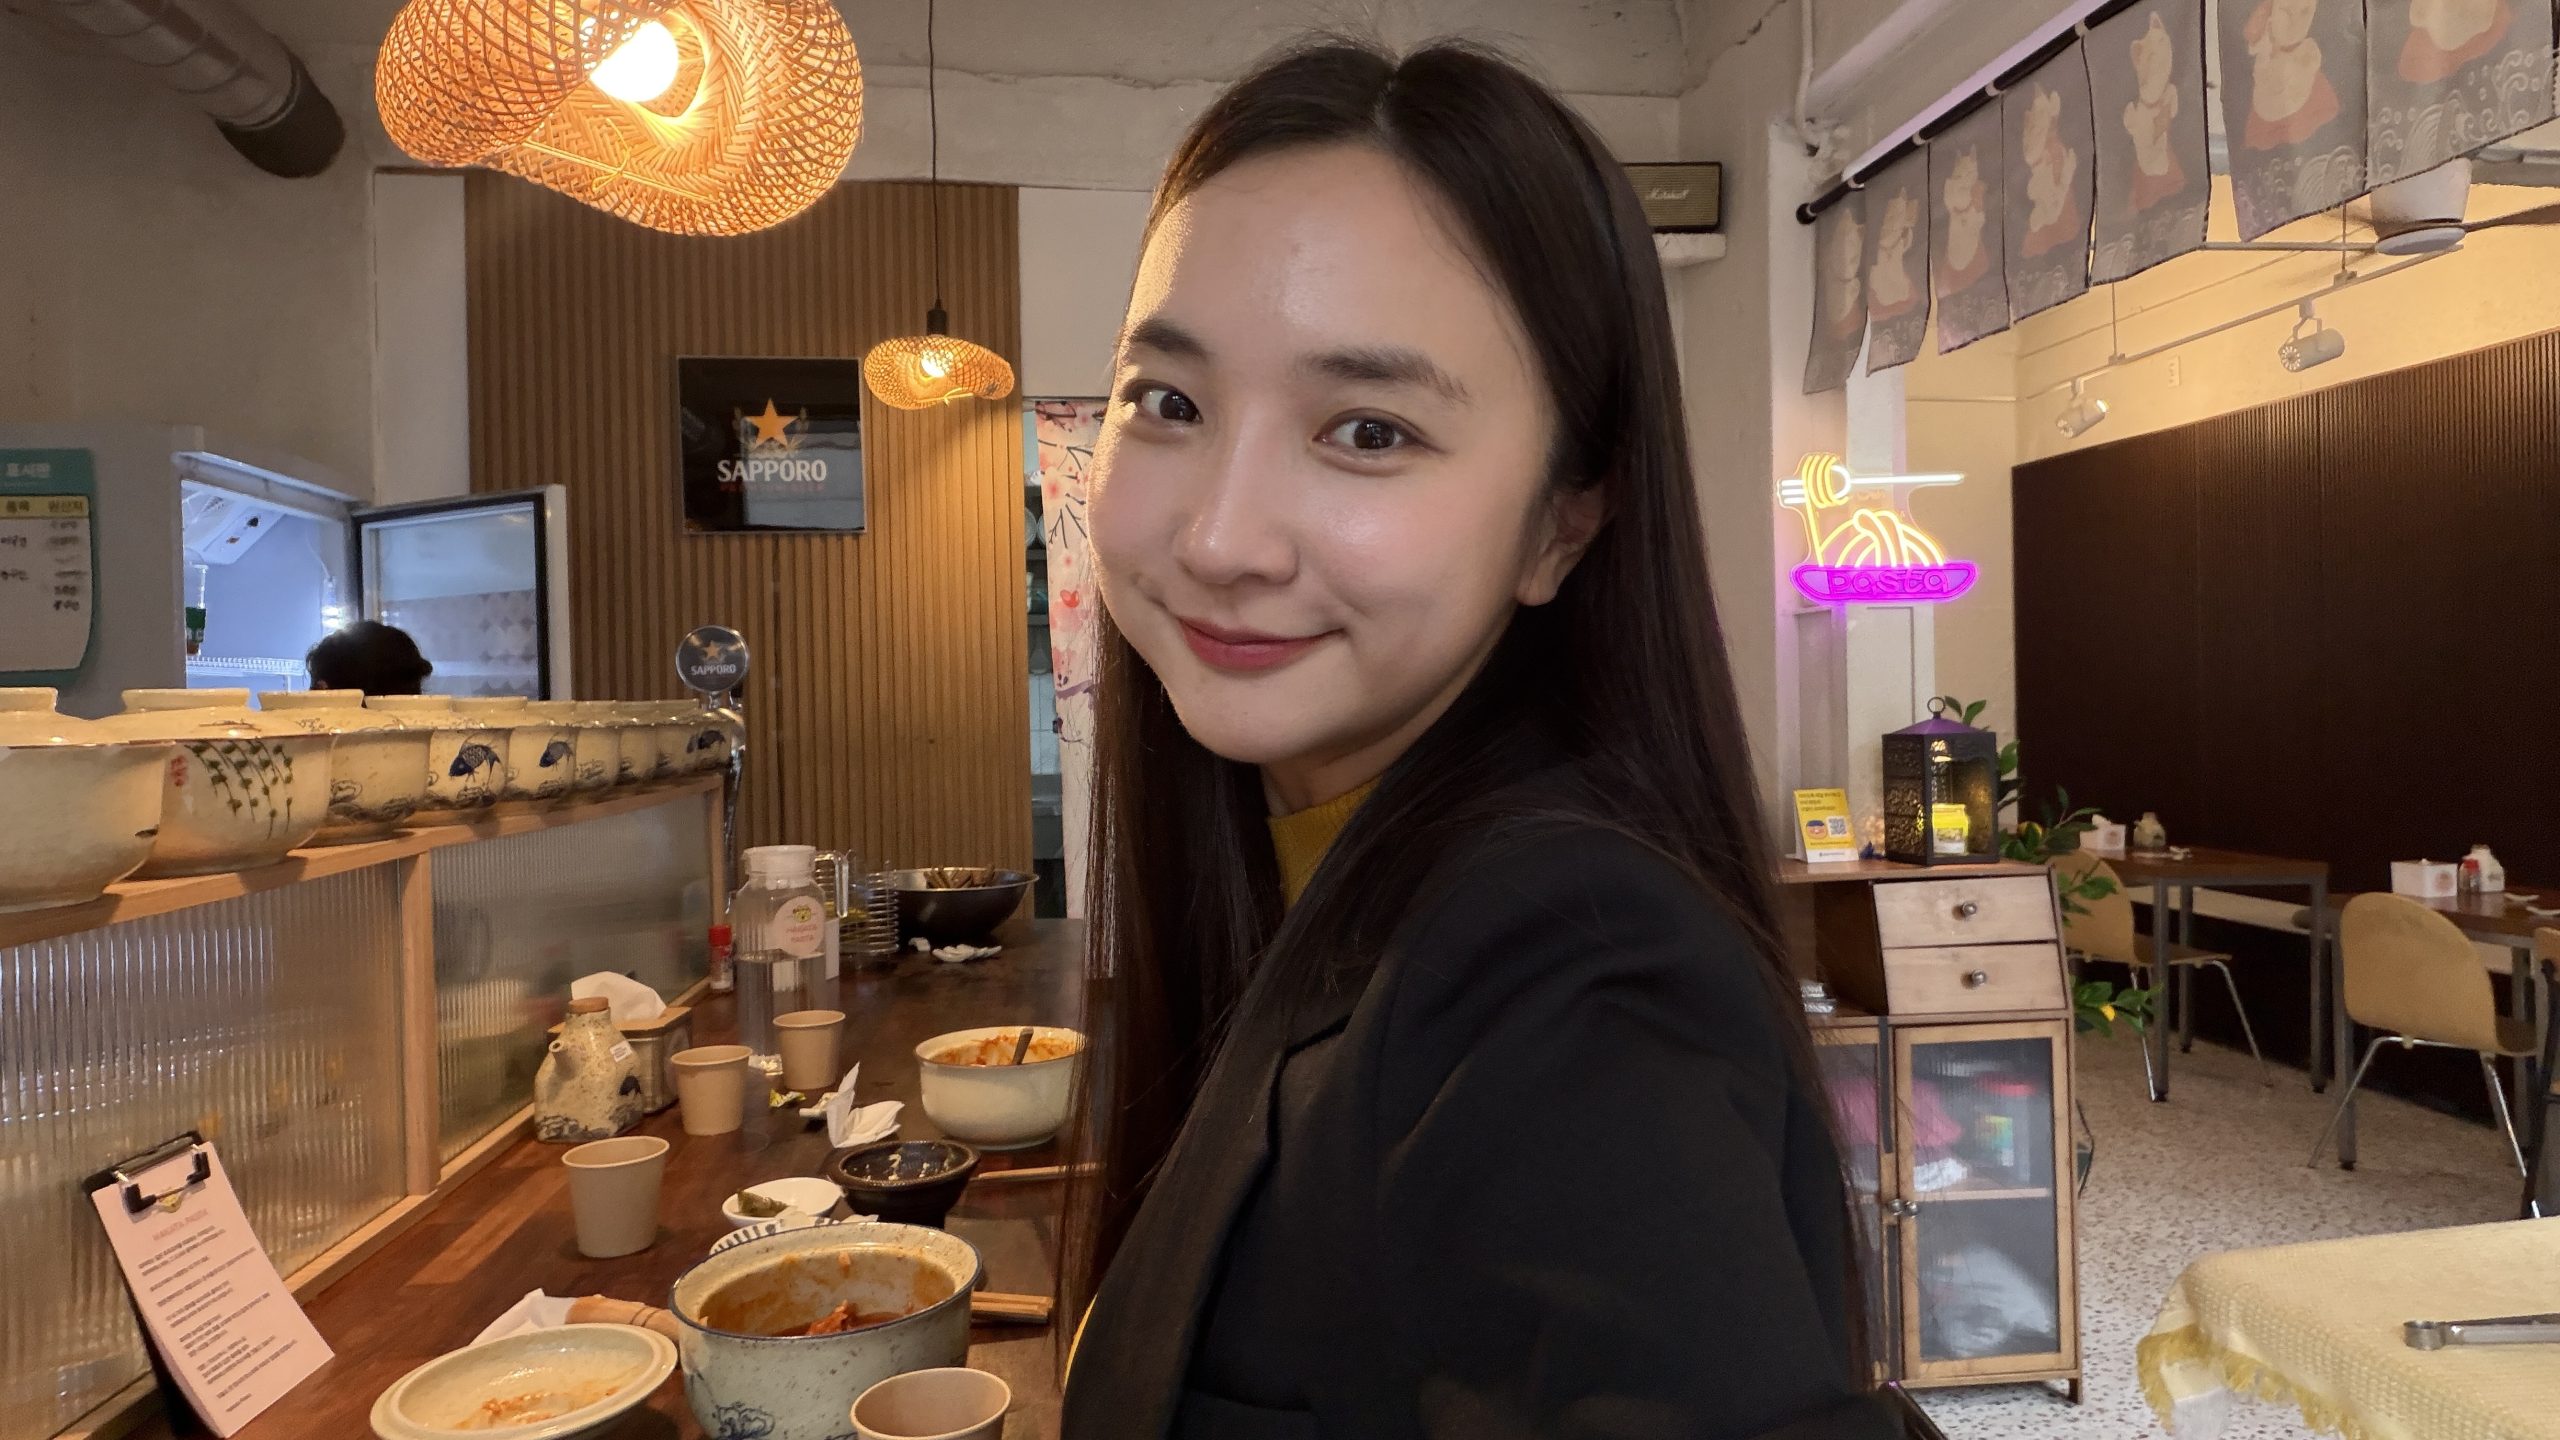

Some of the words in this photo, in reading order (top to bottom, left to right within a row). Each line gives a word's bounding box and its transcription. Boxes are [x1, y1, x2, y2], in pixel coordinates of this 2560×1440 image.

[717, 459, 827, 482] SAPPORO
[1828, 567, 1949, 597] pasta
[690, 663, 737, 676] SAPPORO
